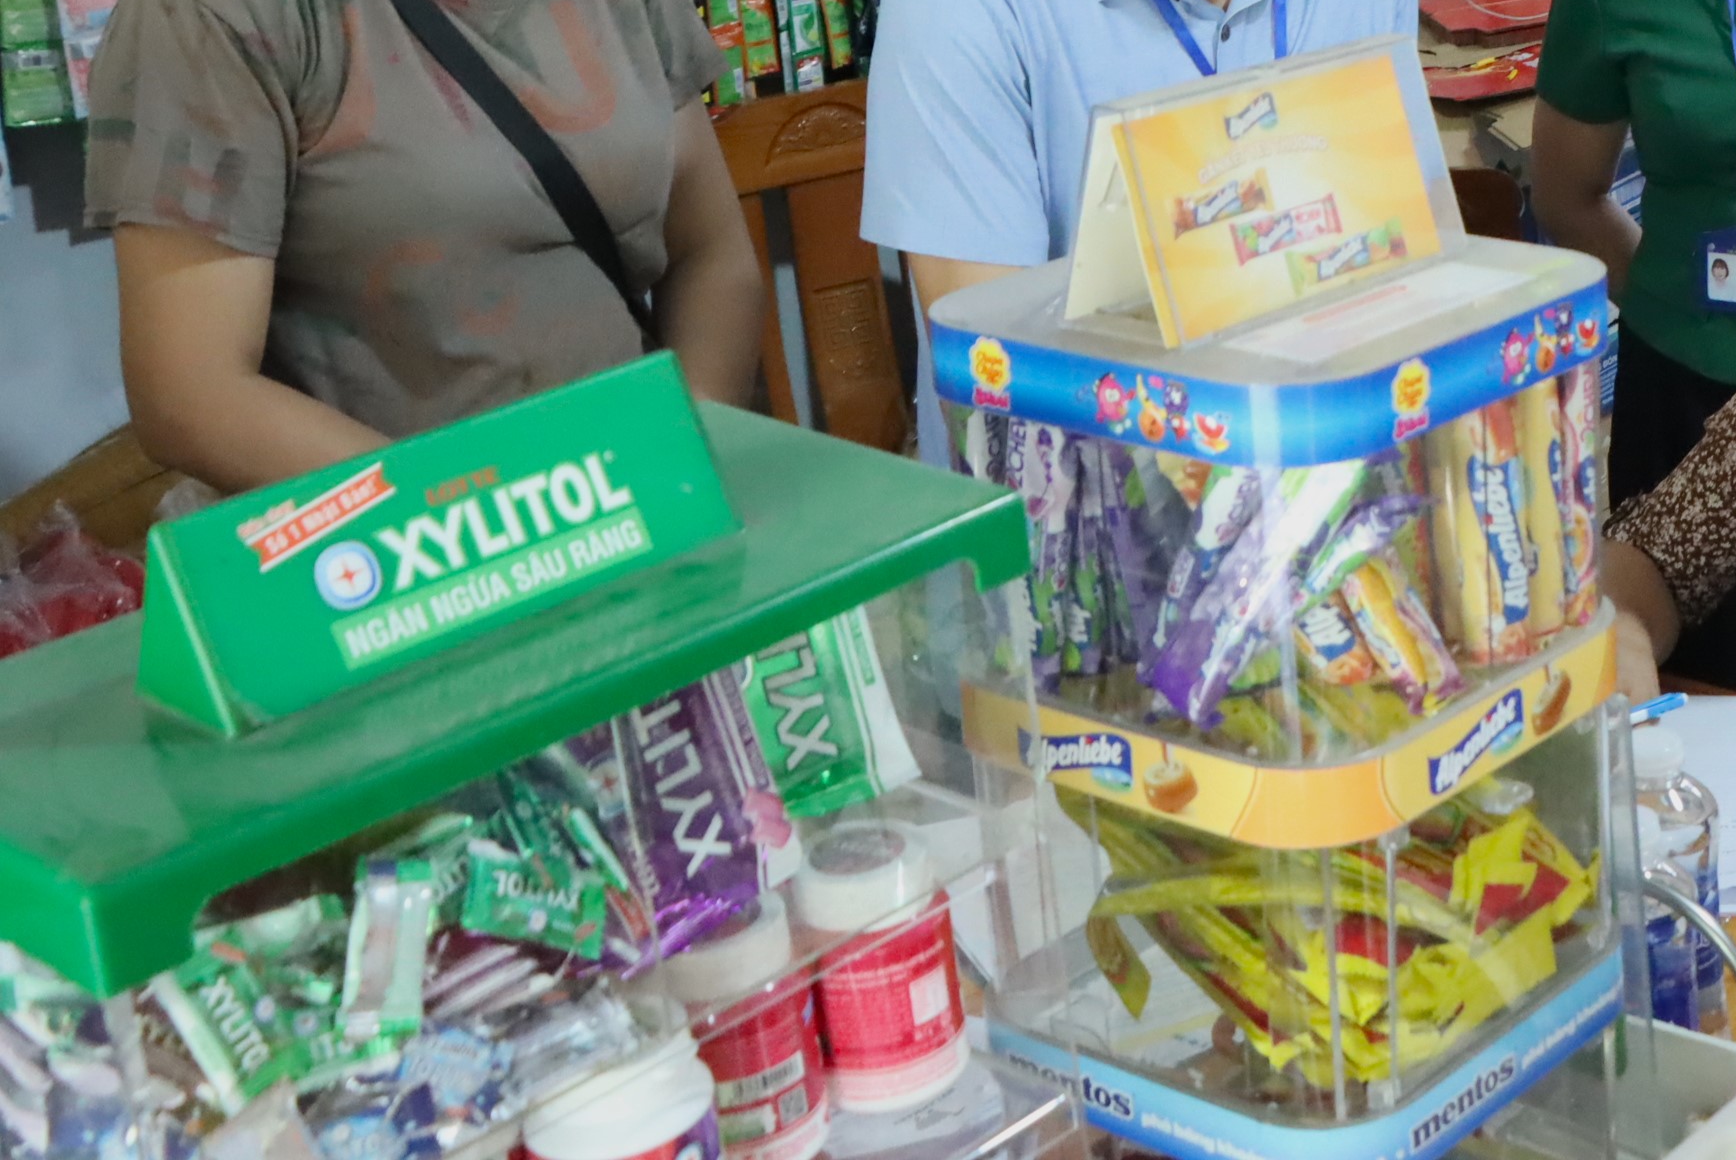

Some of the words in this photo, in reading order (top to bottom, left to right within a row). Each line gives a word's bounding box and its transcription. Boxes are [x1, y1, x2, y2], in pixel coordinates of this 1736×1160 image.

[373, 451, 633, 592] XYLITOL
[513, 551, 568, 594] SÂU
[630, 697, 733, 880] XYLIT
[1435, 694, 1518, 790] Alpenliebe
[1410, 1054, 1516, 1151] mentos
